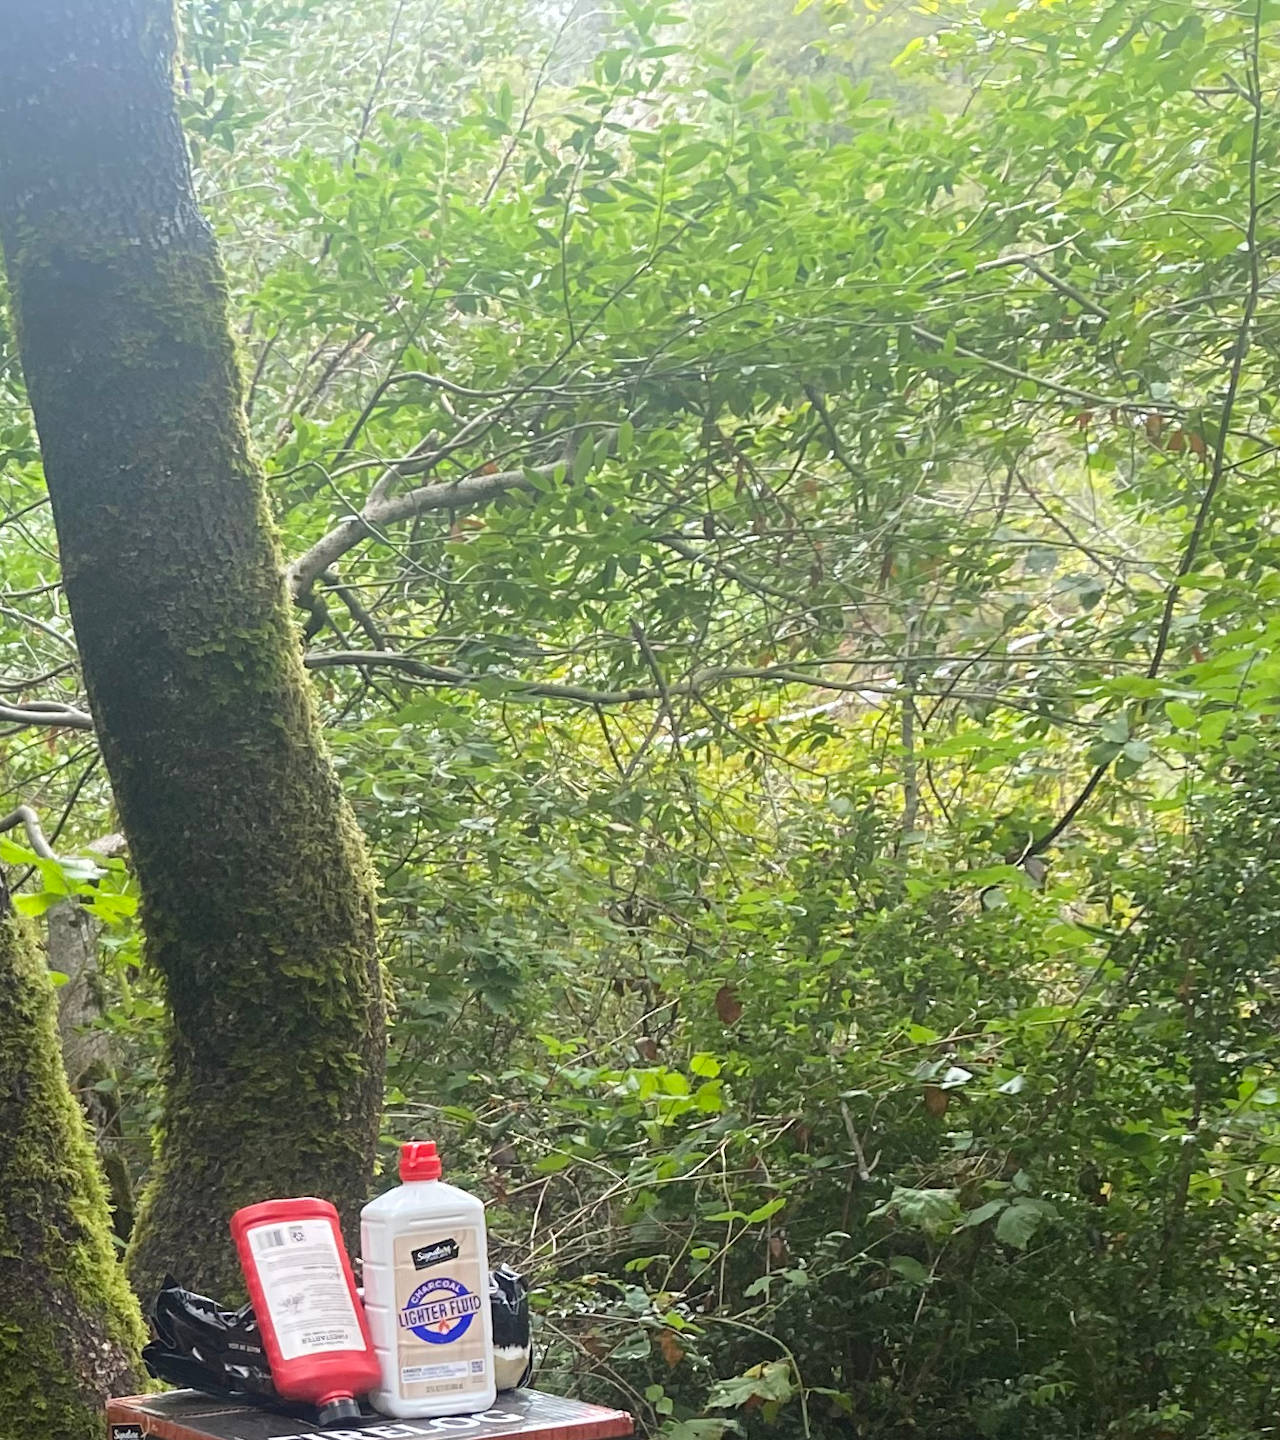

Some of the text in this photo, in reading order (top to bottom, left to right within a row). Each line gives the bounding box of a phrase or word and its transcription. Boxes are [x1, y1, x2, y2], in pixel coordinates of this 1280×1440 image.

[411, 1280, 461, 1304] CHARCOAL
[398, 1295, 482, 1328] LIGHTER FLUID
